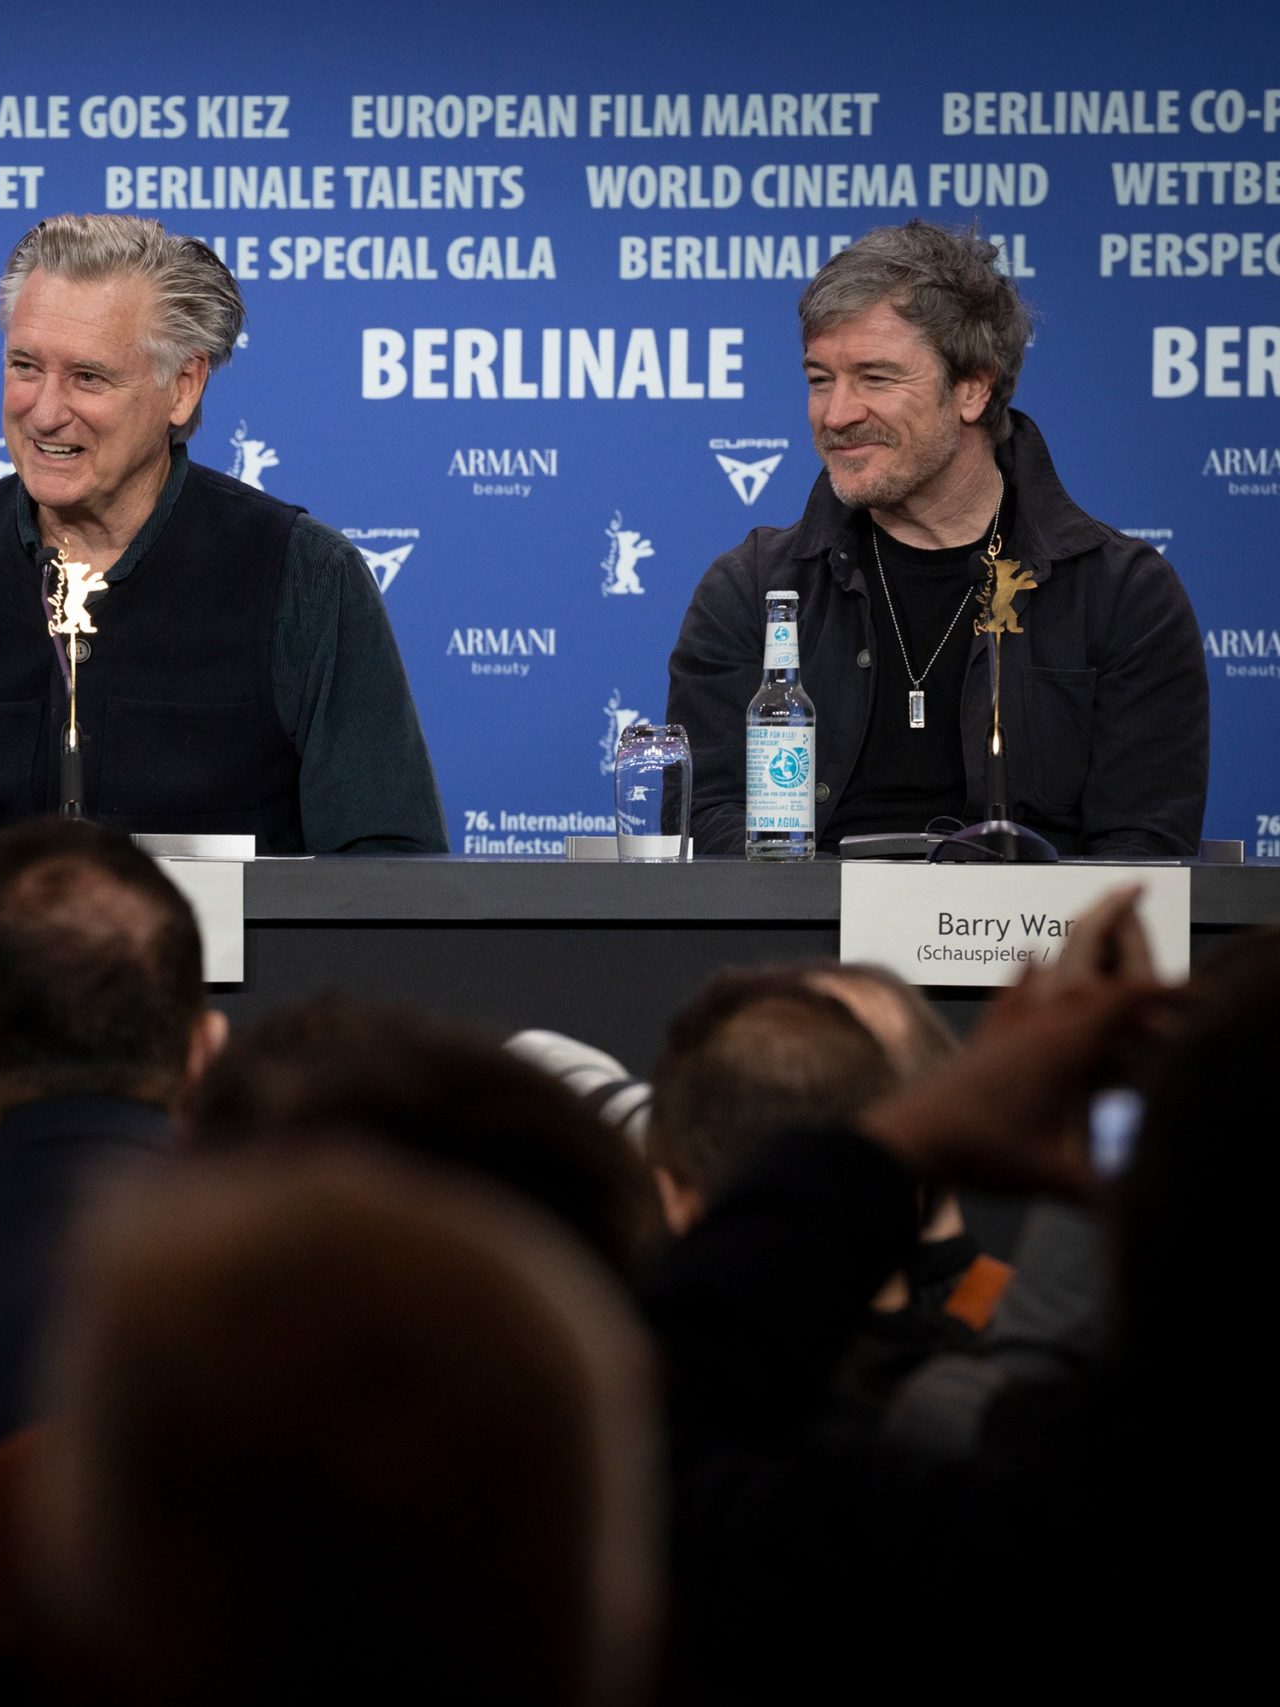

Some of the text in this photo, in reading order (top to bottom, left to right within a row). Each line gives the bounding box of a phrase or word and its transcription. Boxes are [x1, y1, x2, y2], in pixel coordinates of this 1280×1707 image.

[79, 95, 188, 139] GOES
[197, 96, 290, 138] KIEZ
[351, 93, 880, 138] EUROPEAN FILM MARKET
[942, 91, 1180, 135] BERLINALE
[105, 165, 525, 210] BERLINALE TALENTS
[585, 163, 1049, 209] WORLD CINEMA FUND
[268, 236, 439, 280] SPECIAL
[446, 236, 557, 280] GALA
[361, 328, 745, 400] BERLINALE
[448, 448, 558, 476] ARMANI
[472, 482, 532, 498] beauty
[446, 627, 556, 657] ARMANI
[470, 660, 530, 677] beauty
[464, 810, 496, 832] 76.
[758, 816, 775, 828] CON
[777, 816, 800, 828] AGUA
[938, 912, 1011, 943] Barry
